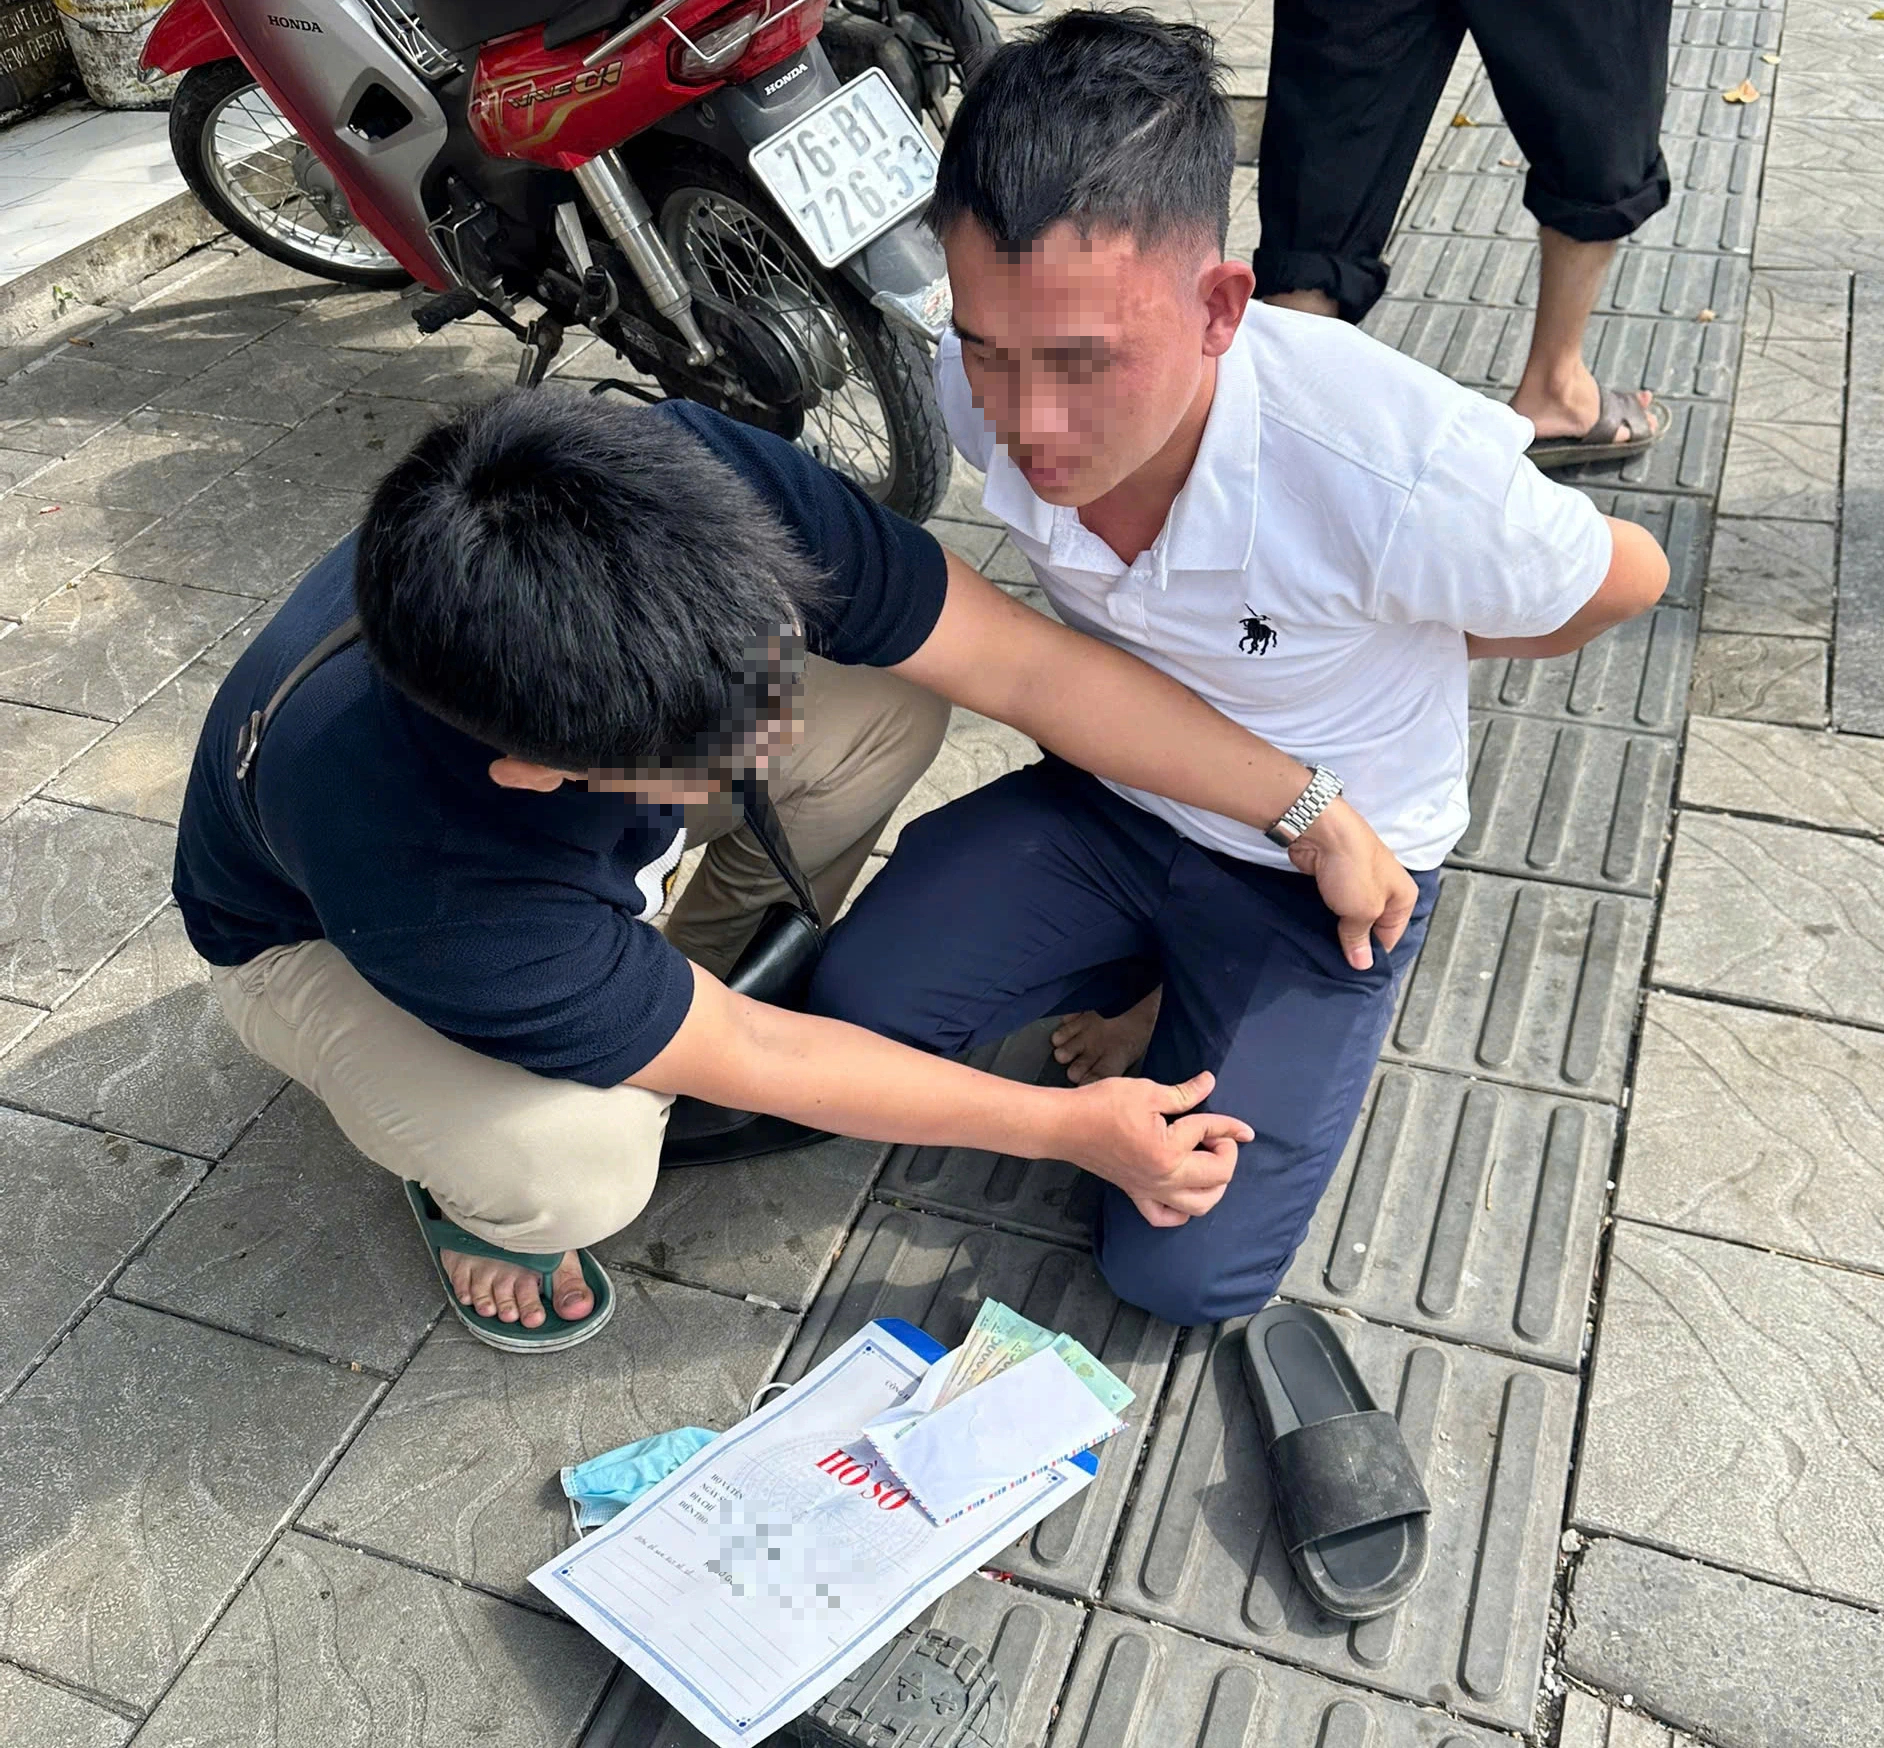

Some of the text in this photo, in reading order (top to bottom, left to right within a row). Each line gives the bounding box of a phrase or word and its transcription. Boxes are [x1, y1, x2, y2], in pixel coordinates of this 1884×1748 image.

[267, 14, 325, 34] HONDA
[764, 62, 809, 96] HONDA
[773, 92, 889, 195] 76-B1
[800, 134, 935, 254] 726.53
[814, 1448, 878, 1486] HỒ
